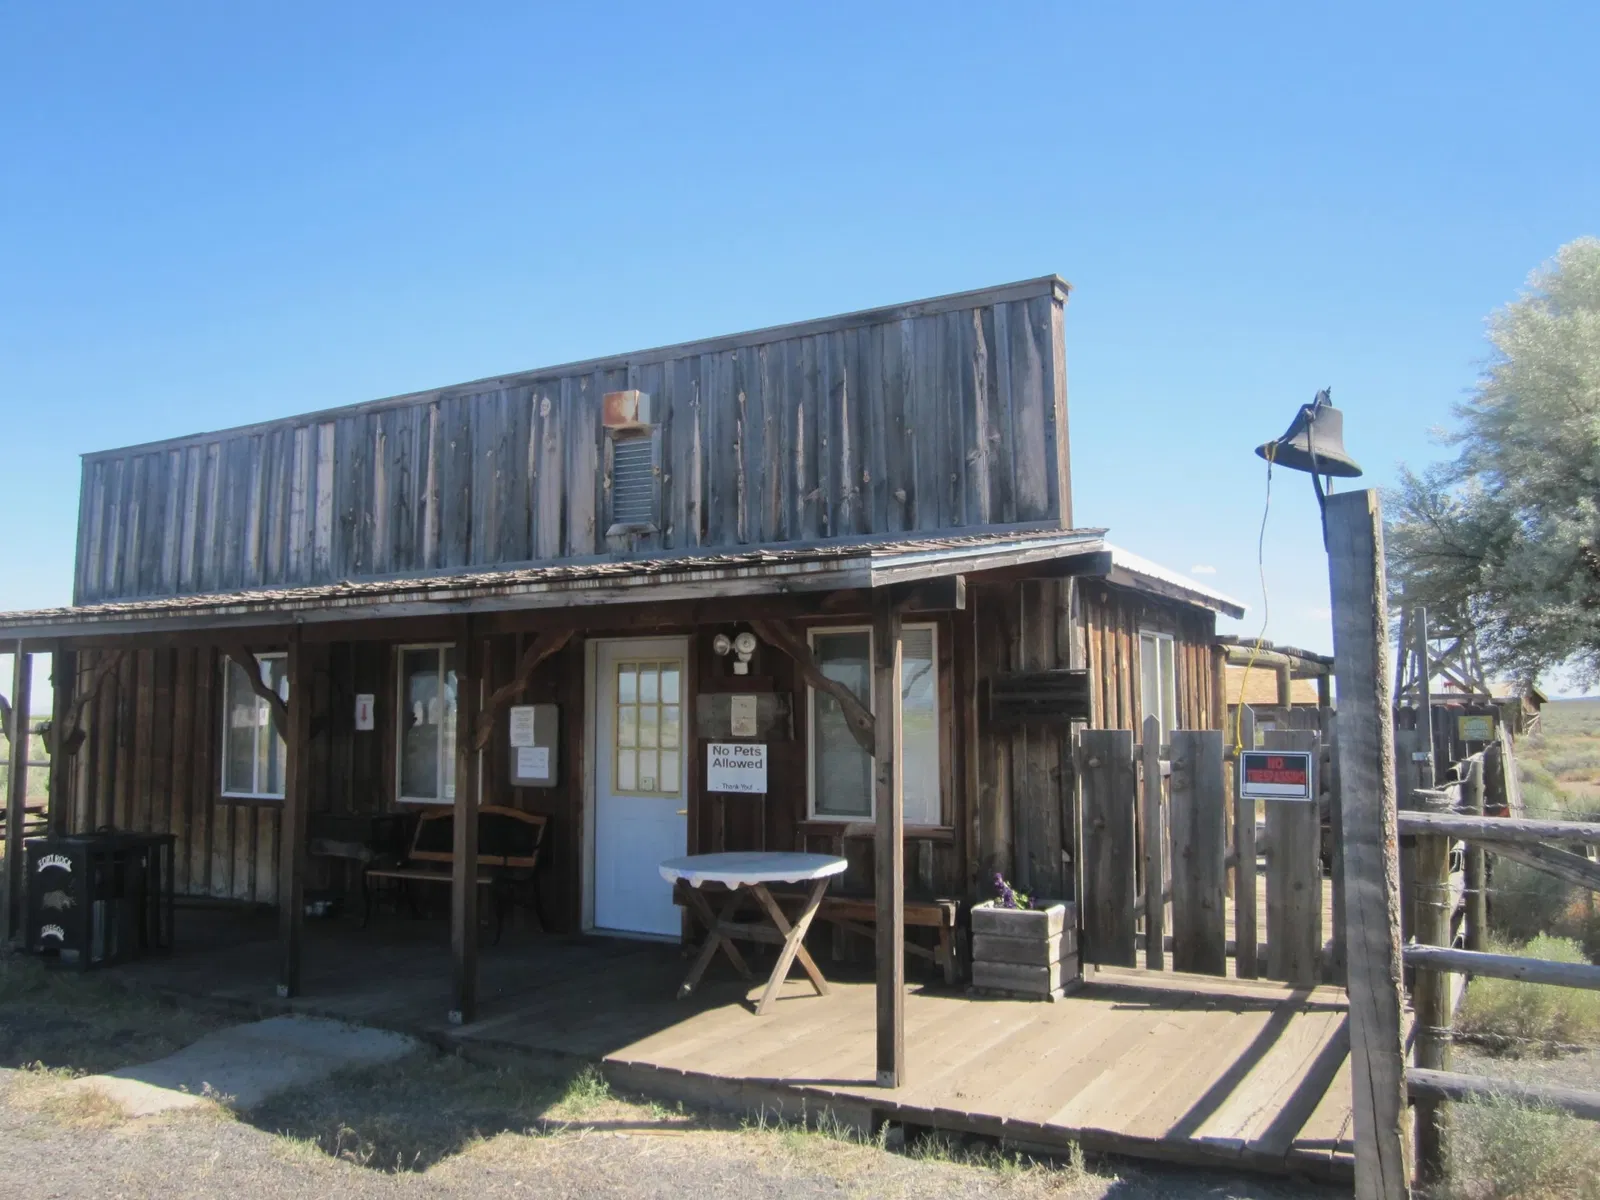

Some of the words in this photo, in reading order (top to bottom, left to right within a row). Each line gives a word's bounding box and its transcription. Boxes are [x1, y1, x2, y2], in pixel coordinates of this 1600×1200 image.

[712, 745, 730, 756] No
[734, 745, 762, 756] Pets
[712, 758, 763, 769] Allowed
[1267, 756, 1285, 769] NO
[37, 853, 54, 866] FORT
[54, 853, 72, 866] ROCK
[41, 924, 65, 936] OREGON
